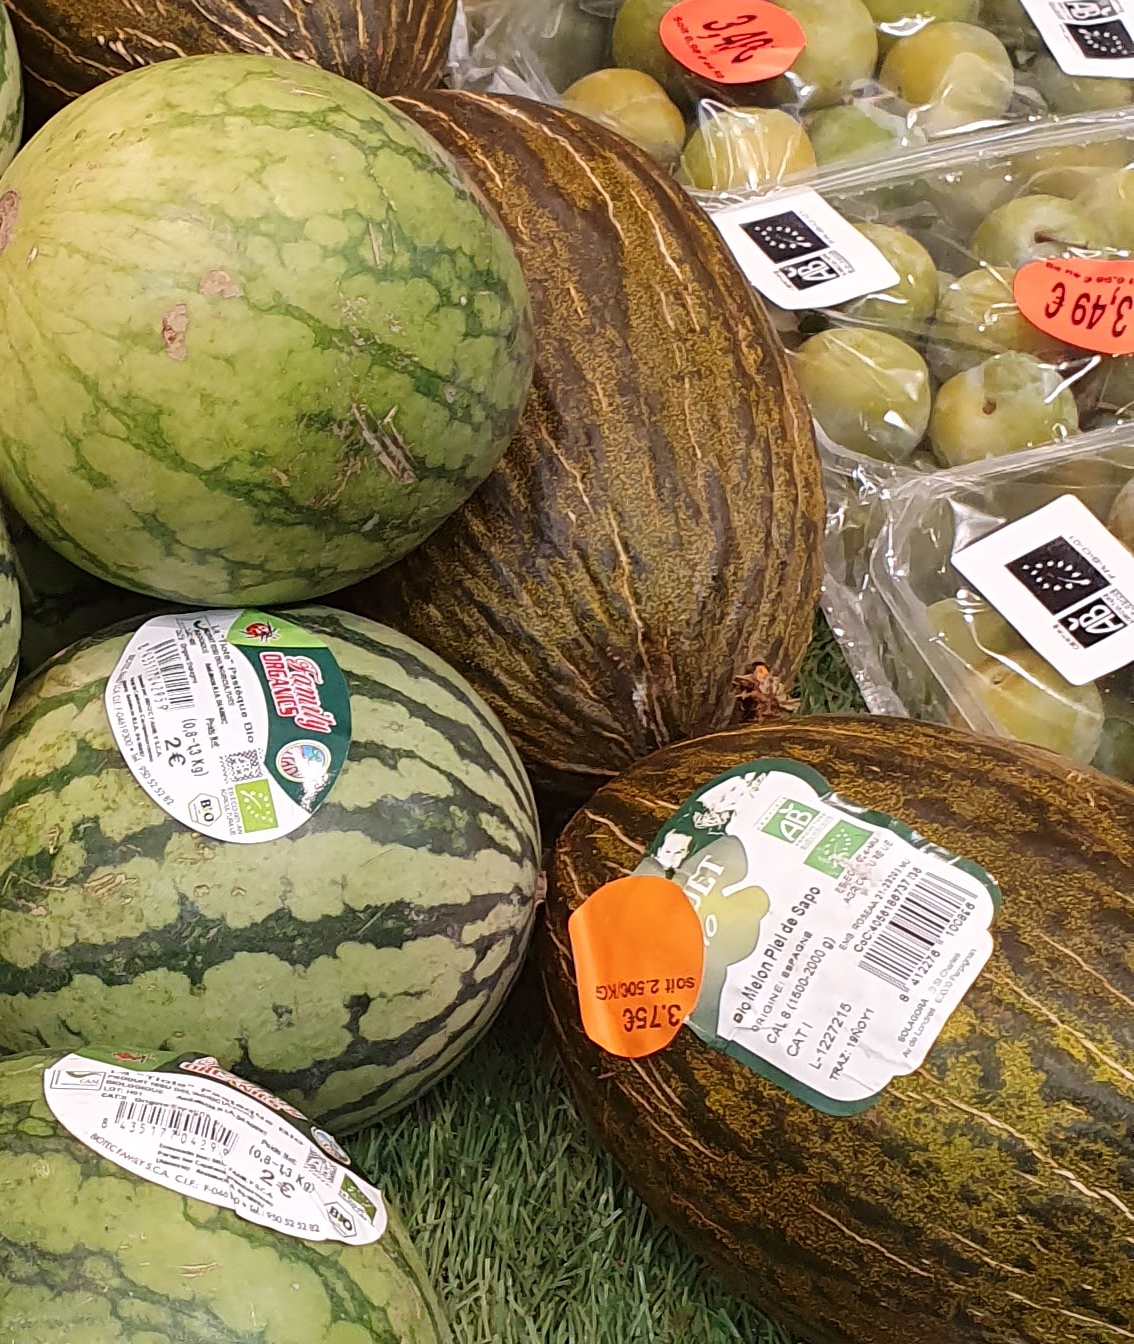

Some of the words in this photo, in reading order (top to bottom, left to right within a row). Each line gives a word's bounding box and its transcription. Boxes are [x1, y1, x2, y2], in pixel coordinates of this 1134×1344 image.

[1070, 287, 1133, 336] 3,49
[259, 652, 300, 716] ORGANICS
[286, 655, 337, 732] Family
[782, 805, 813, 842] AB
[743, 959, 773, 1001] Melon
[765, 932, 788, 961] Piel
[780, 914, 800, 935] de
[791, 881, 822, 919] Sapo
[665, 977, 694, 993] soit
[898, 992, 911, 1003] 8
[621, 1005, 680, 1033] 3.75€
[764, 1018, 788, 1045] CAL
[808, 1000, 854, 1070] L-1227215
[896, 996, 931, 1043] SOLAGORA
[784, 1027, 810, 1058] CAT
[100, 1117, 109, 1129] 8
